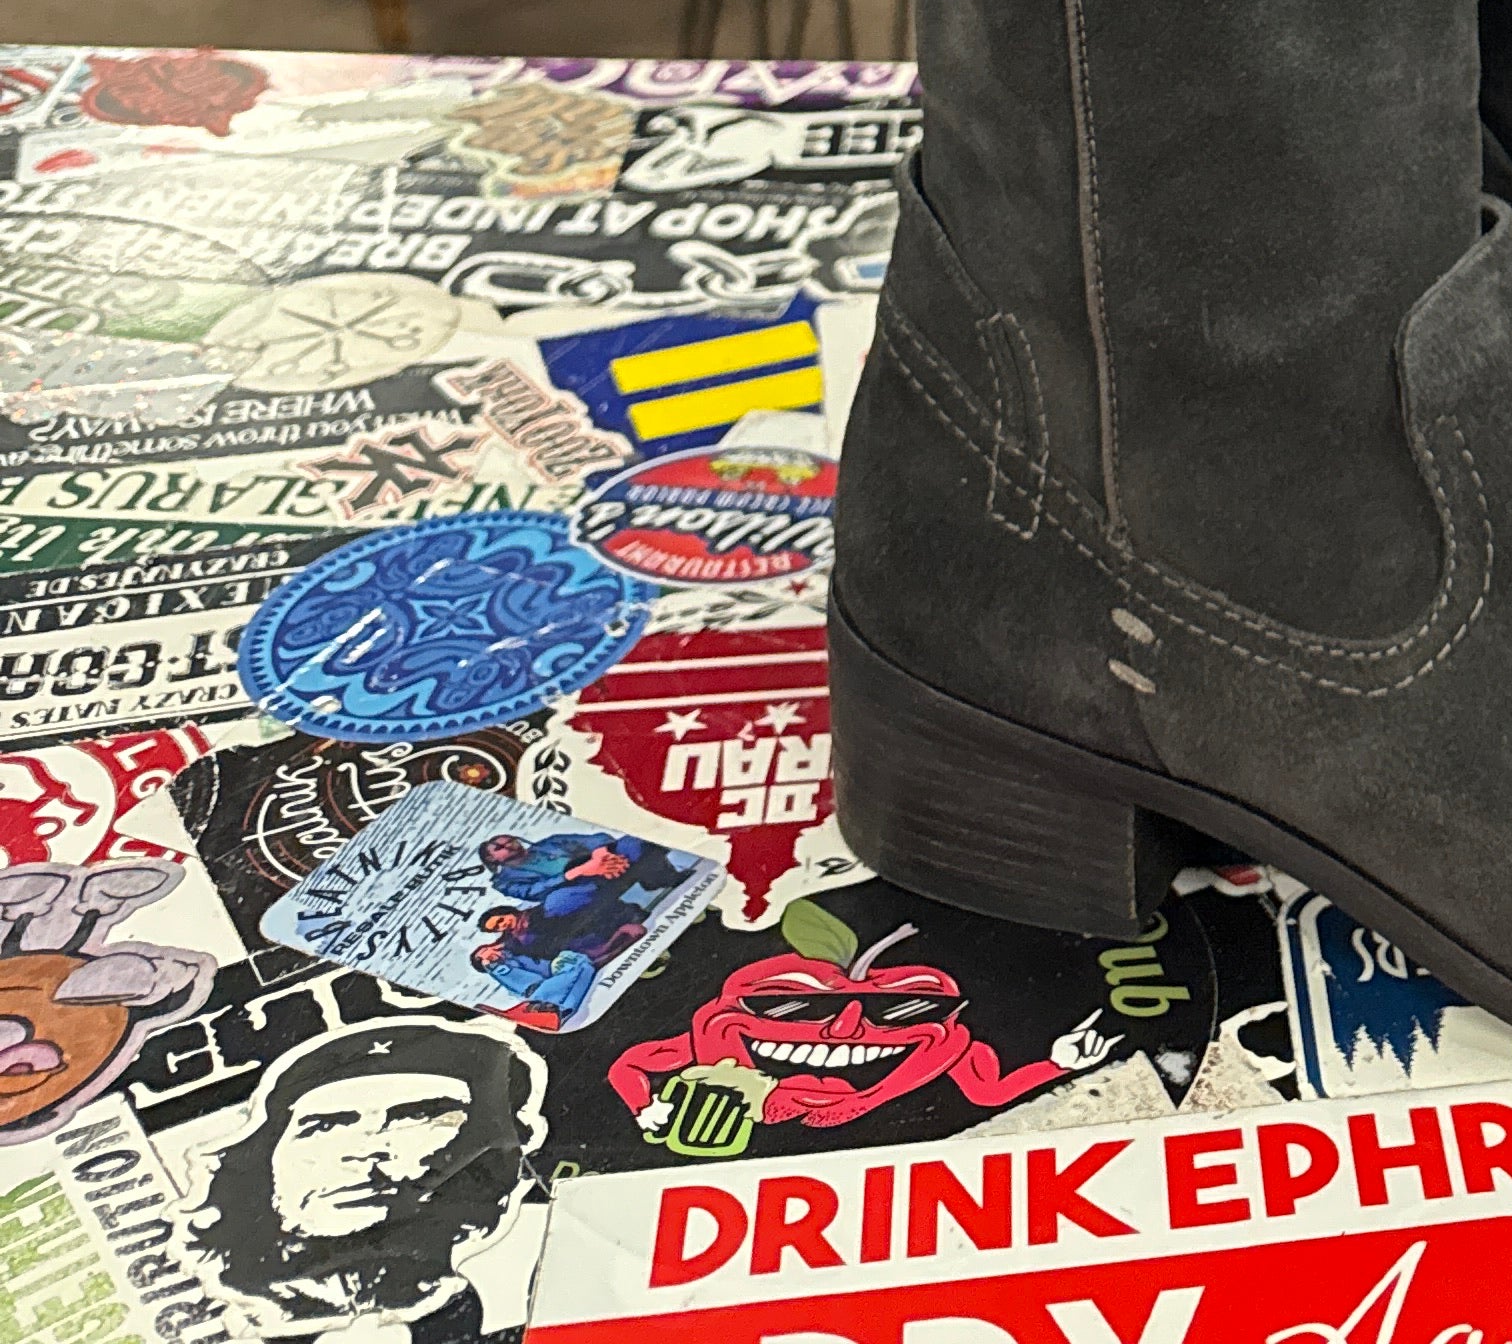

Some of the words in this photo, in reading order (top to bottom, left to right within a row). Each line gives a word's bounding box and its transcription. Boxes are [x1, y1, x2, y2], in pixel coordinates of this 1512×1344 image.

[553, 201, 654, 233] AT
[223, 388, 374, 427] WHERE
[200, 420, 300, 452] throw
[114, 682, 238, 717] CRAZY
[715, 780, 821, 830] DC
[599, 920, 668, 991] Downtown
[664, 871, 720, 926] Appleton
[648, 1138, 1140, 1289] DRINK
